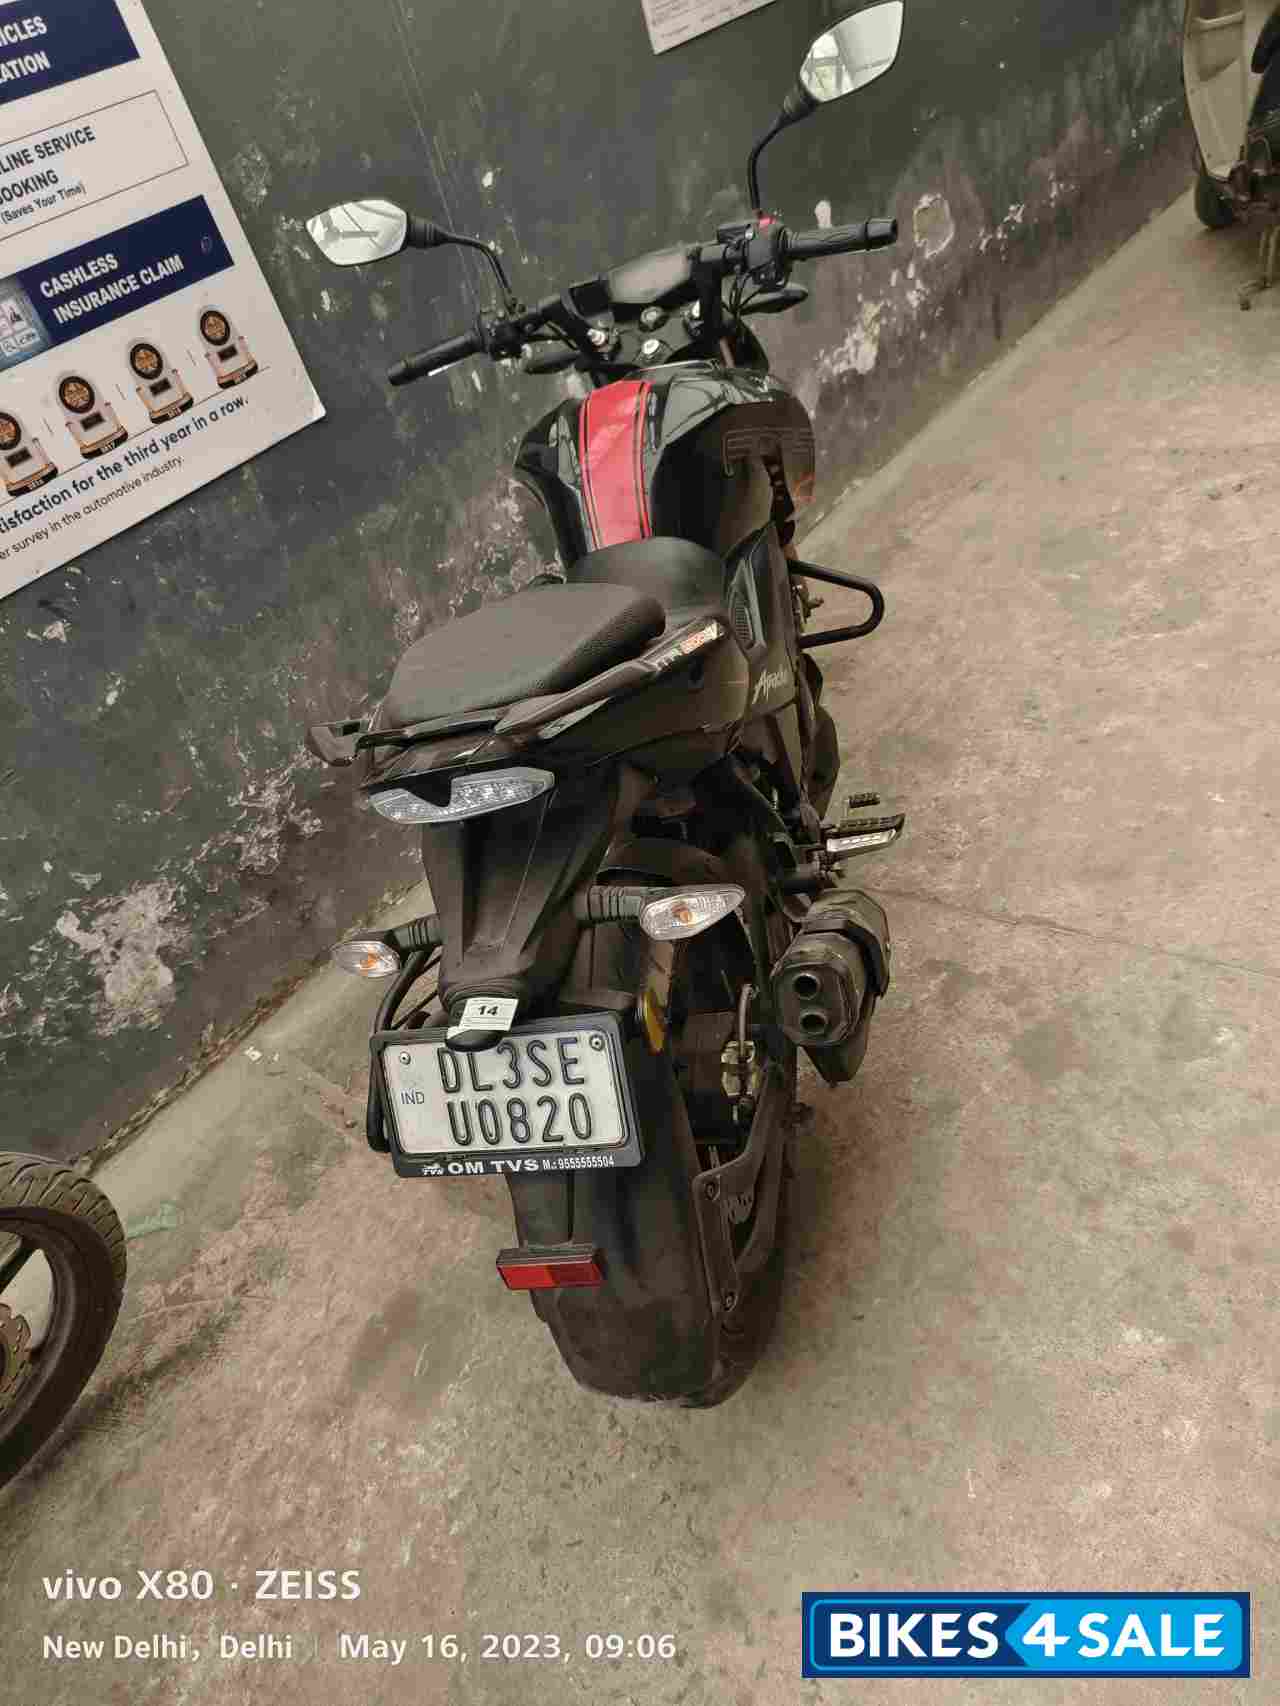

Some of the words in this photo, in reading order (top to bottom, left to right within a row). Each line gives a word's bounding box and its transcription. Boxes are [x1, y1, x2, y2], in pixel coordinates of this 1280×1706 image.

[0, 16, 48, 47] ICLES
[0, 51, 51, 84] ATION
[0, 148, 34, 176] LINE
[34, 126, 96, 159] SERVICE
[0, 170, 59, 206] OOKING
[33, 194, 57, 209] Your
[40, 253, 119, 298] CASHLESS
[52, 275, 141, 324] INSURANCE
[140, 254, 184, 285] CLAIM
[72, 476, 95, 495] for
[96, 461, 122, 481] the
[124, 439, 160, 466] third
[160, 423, 192, 451] year
[192, 416, 208, 431] in
[209, 411, 219, 422] a
[12, 527, 49, 553] survey
[49, 519, 62, 533] in
[62, 510, 81, 527] the
[83, 478, 142, 514] automotive
[478, 1005, 499, 1016] 14
[437, 1037, 585, 1093] DL3SE
[401, 1090, 425, 1105] IND
[447, 1092, 592, 1146] U0820
[447, 1160, 485, 1175] OM
[490, 1158, 539, 1174] TVS
